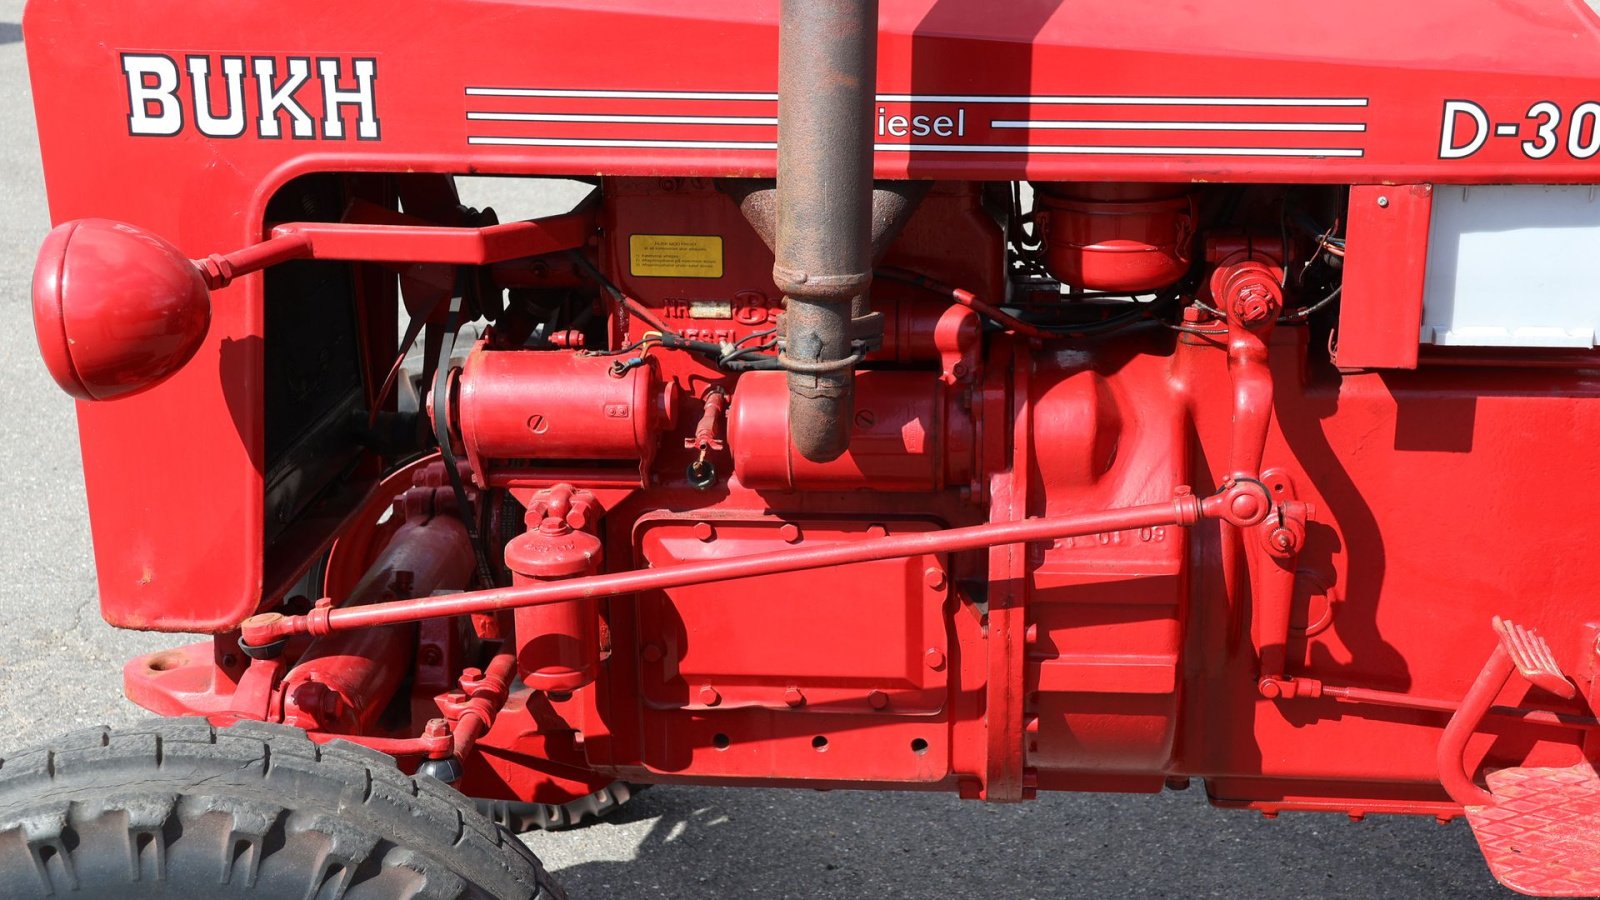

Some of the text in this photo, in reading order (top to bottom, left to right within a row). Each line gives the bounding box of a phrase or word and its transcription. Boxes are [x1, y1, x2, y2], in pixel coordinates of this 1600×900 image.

[120, 52, 381, 141] BUKH
[877, 106, 965, 137] iesel
[1437, 99, 1600, 160] D-30
